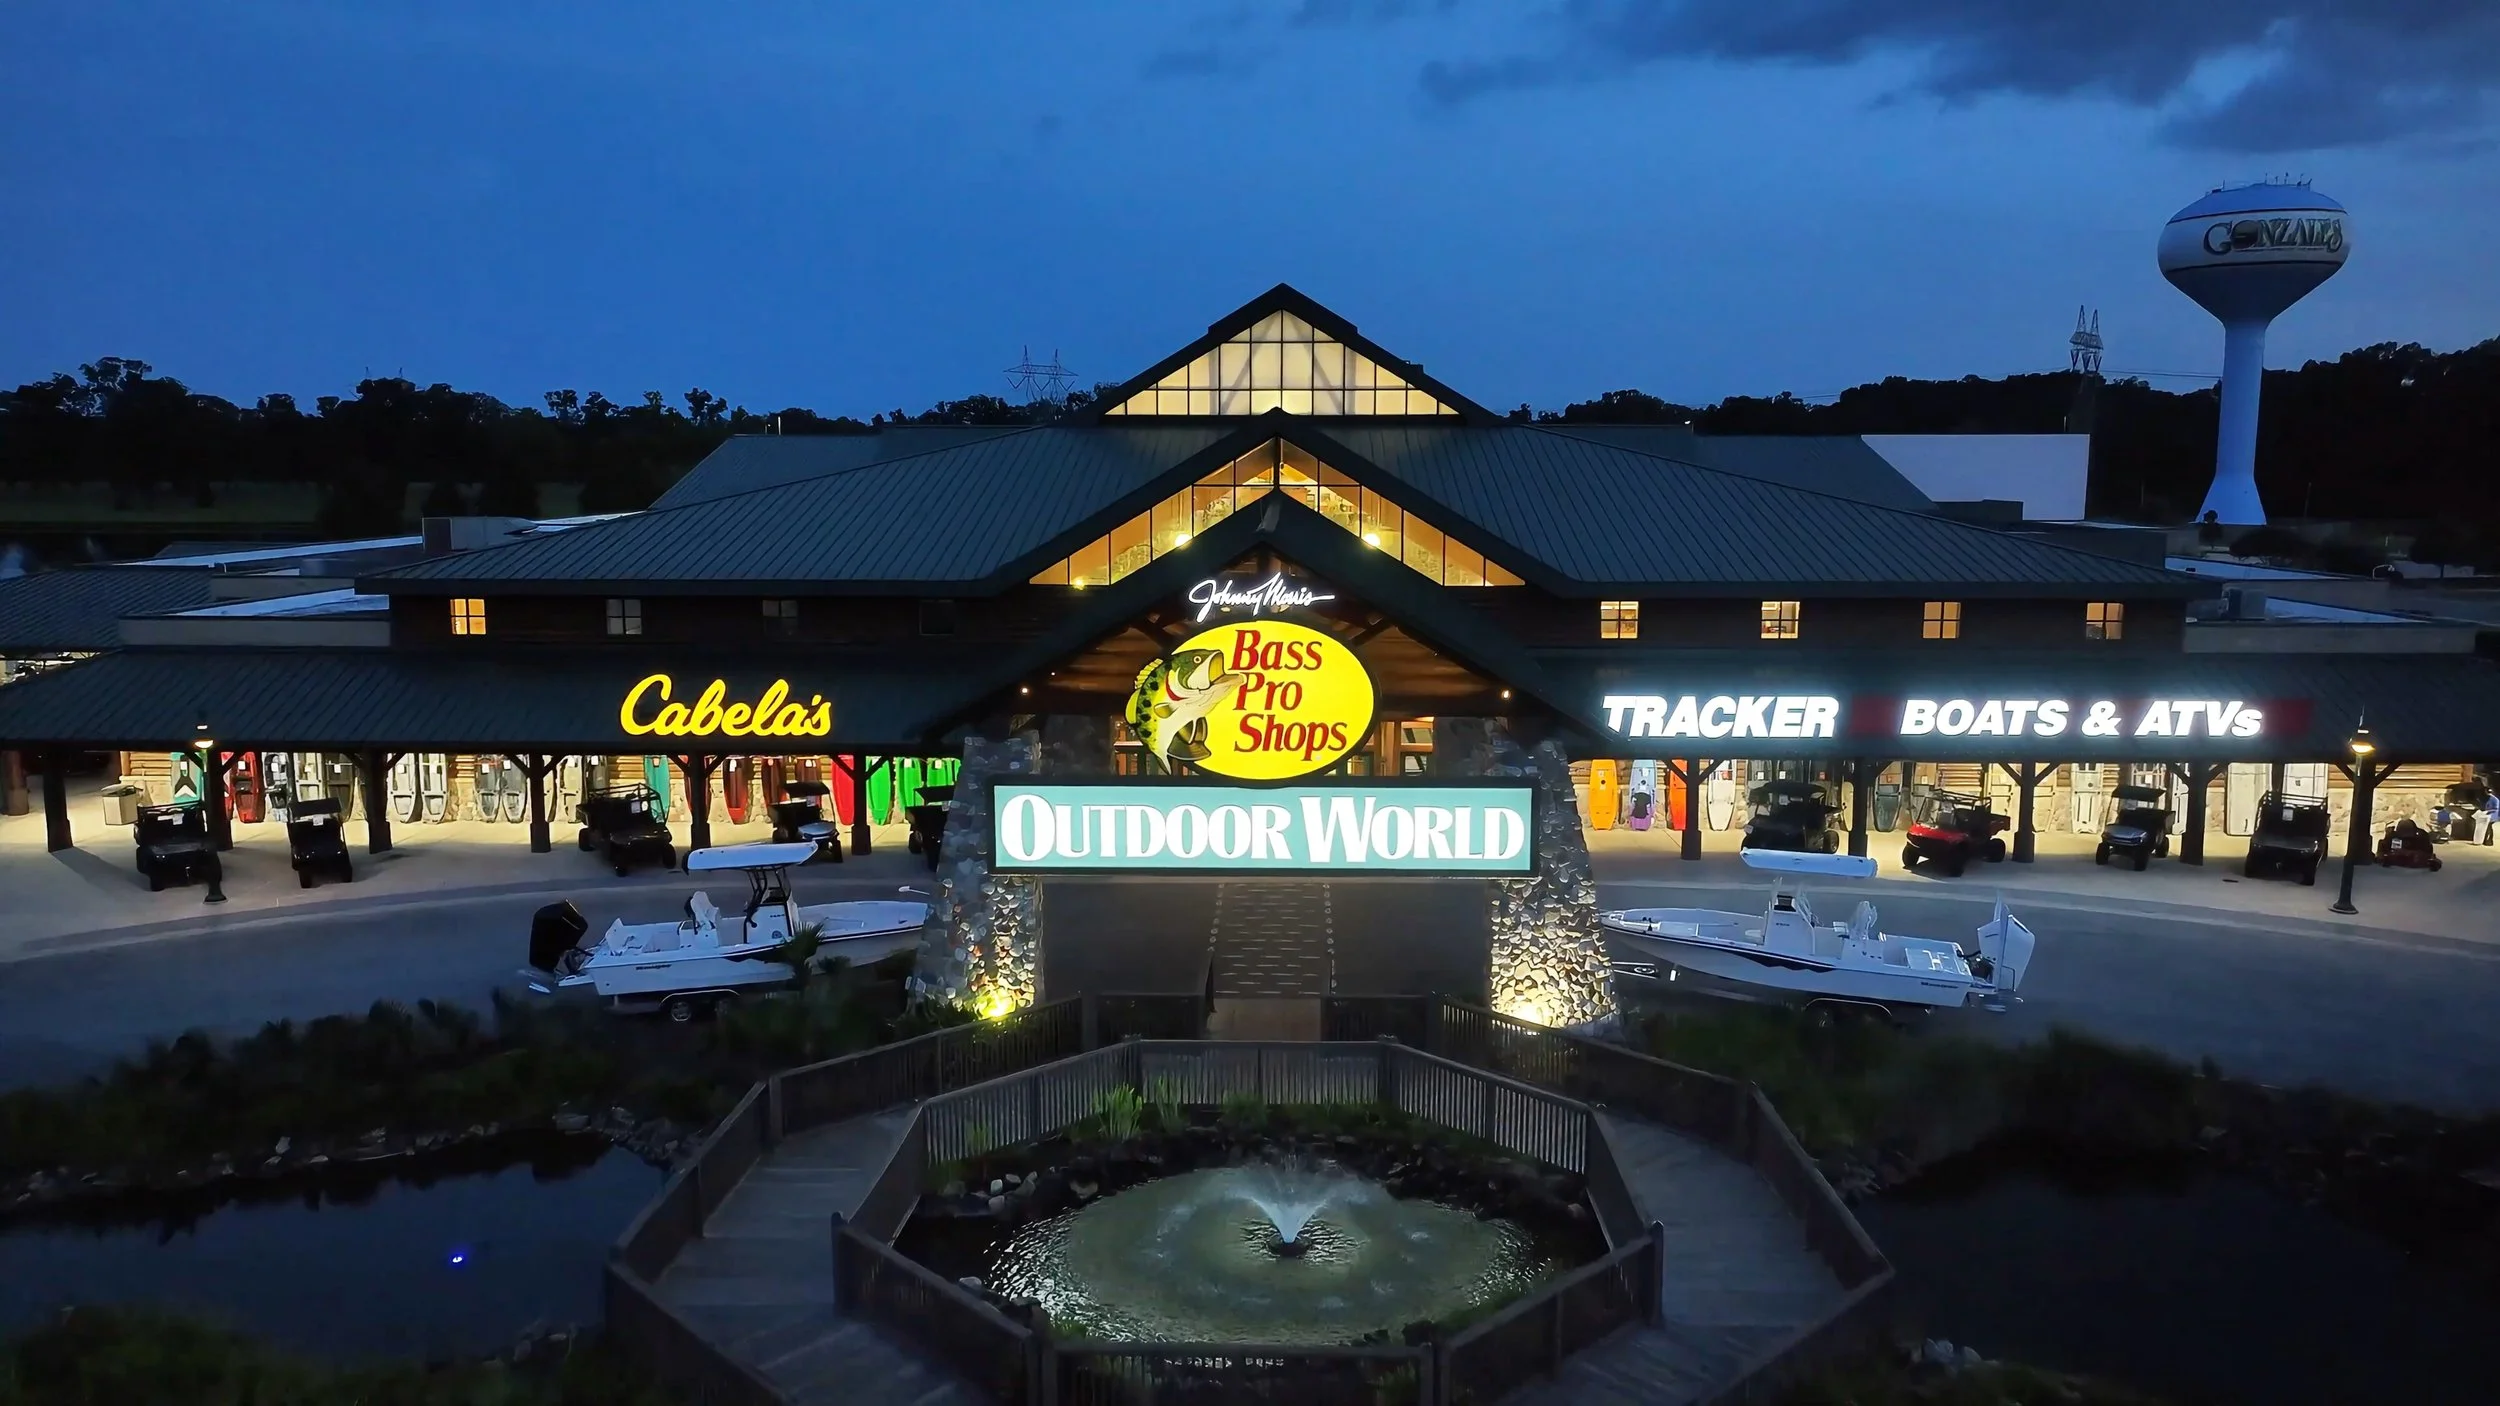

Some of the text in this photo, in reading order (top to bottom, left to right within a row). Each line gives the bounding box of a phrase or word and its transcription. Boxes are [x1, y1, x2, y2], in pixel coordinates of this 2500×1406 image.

[2203, 217, 2344, 256] GONZALES
[1188, 571, 1335, 623] Johnny Morris
[1228, 629, 1323, 671] Bass
[620, 673, 832, 737] Cabela's
[1232, 672, 1303, 711] Pro
[1233, 713, 1348, 762] Shops
[1602, 695, 2263, 739] TRACKER BOATS & ATVs
[1000, 794, 1525, 863] OUTDOOR WORLD
